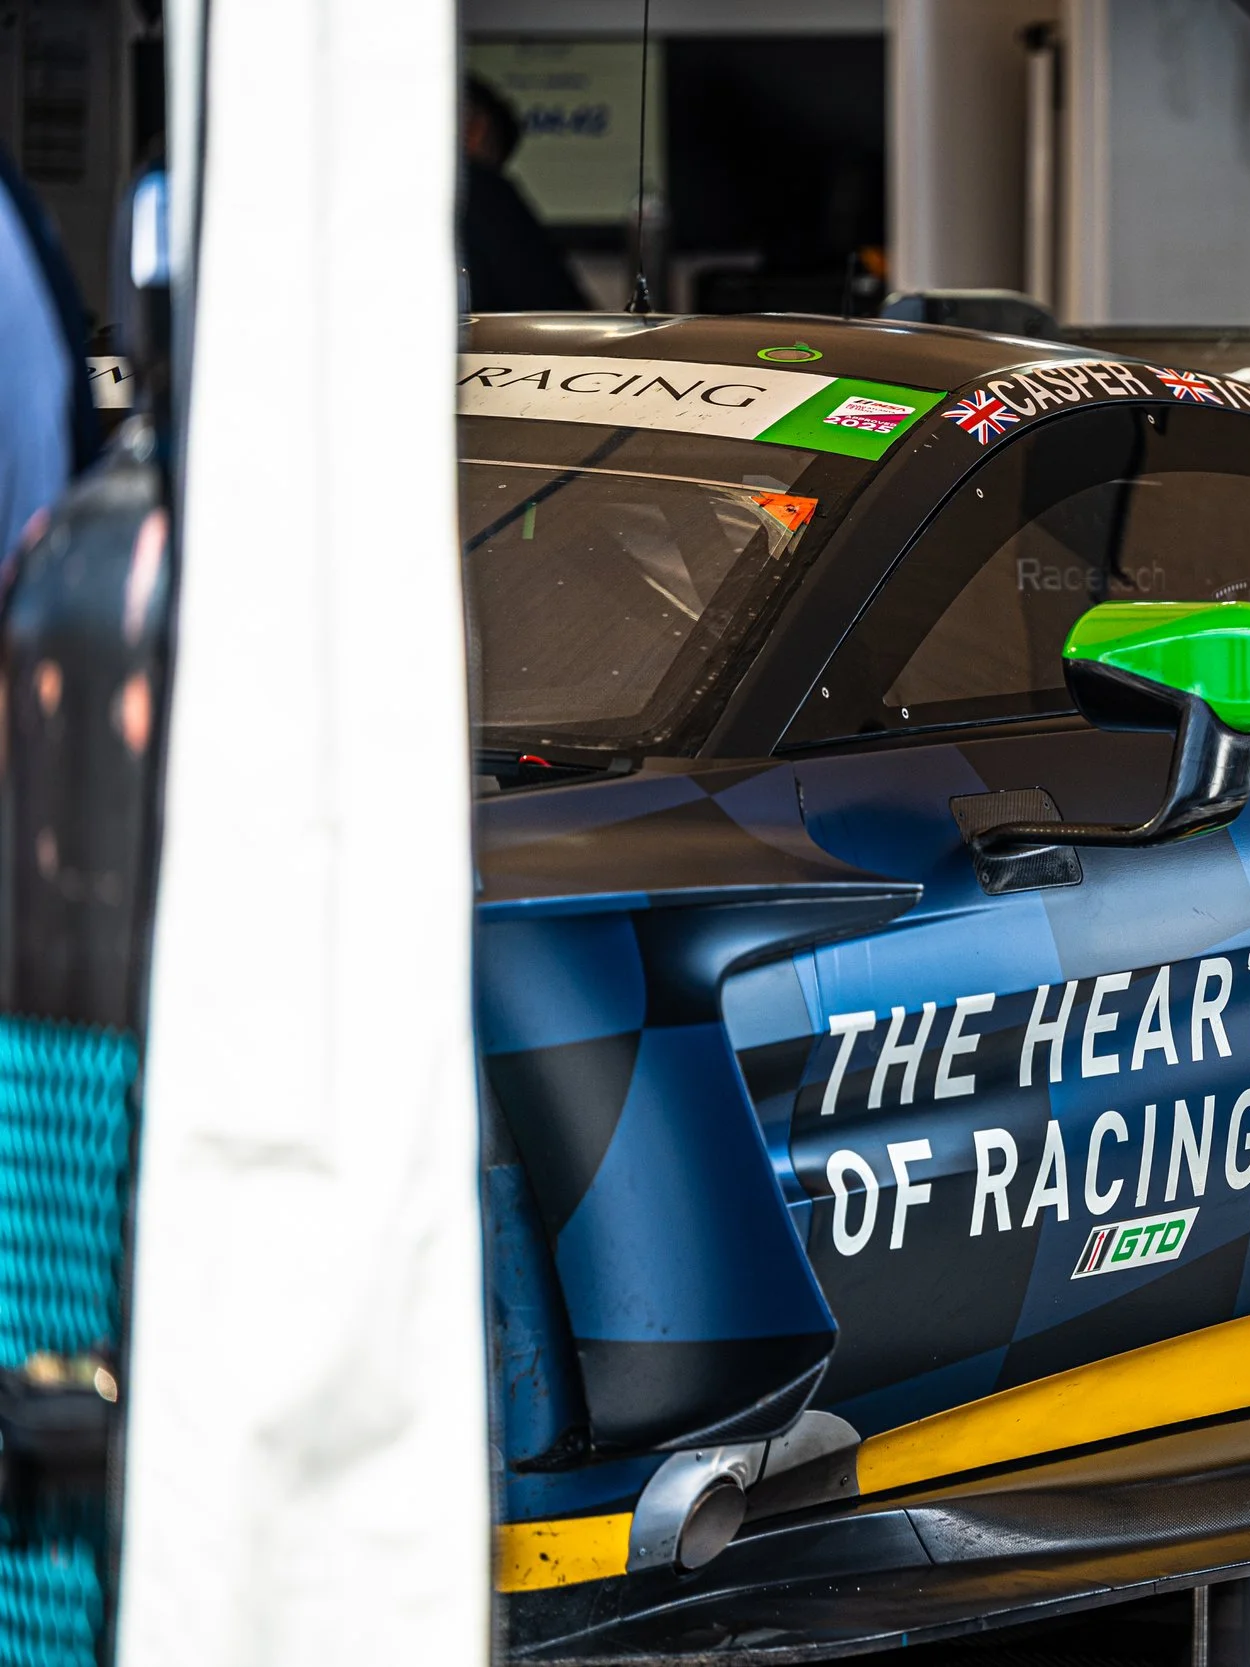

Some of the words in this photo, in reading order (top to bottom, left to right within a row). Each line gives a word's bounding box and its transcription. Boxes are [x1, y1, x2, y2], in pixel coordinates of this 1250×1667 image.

[457, 365, 768, 409] RACING
[986, 362, 1153, 416] CASPER
[823, 416, 895, 433] 2025
[1016, 558, 1166, 591] Raceech
[820, 992, 996, 1115] THE
[826, 1138, 933, 1256] OF
[1111, 1219, 1186, 1263] GTD
